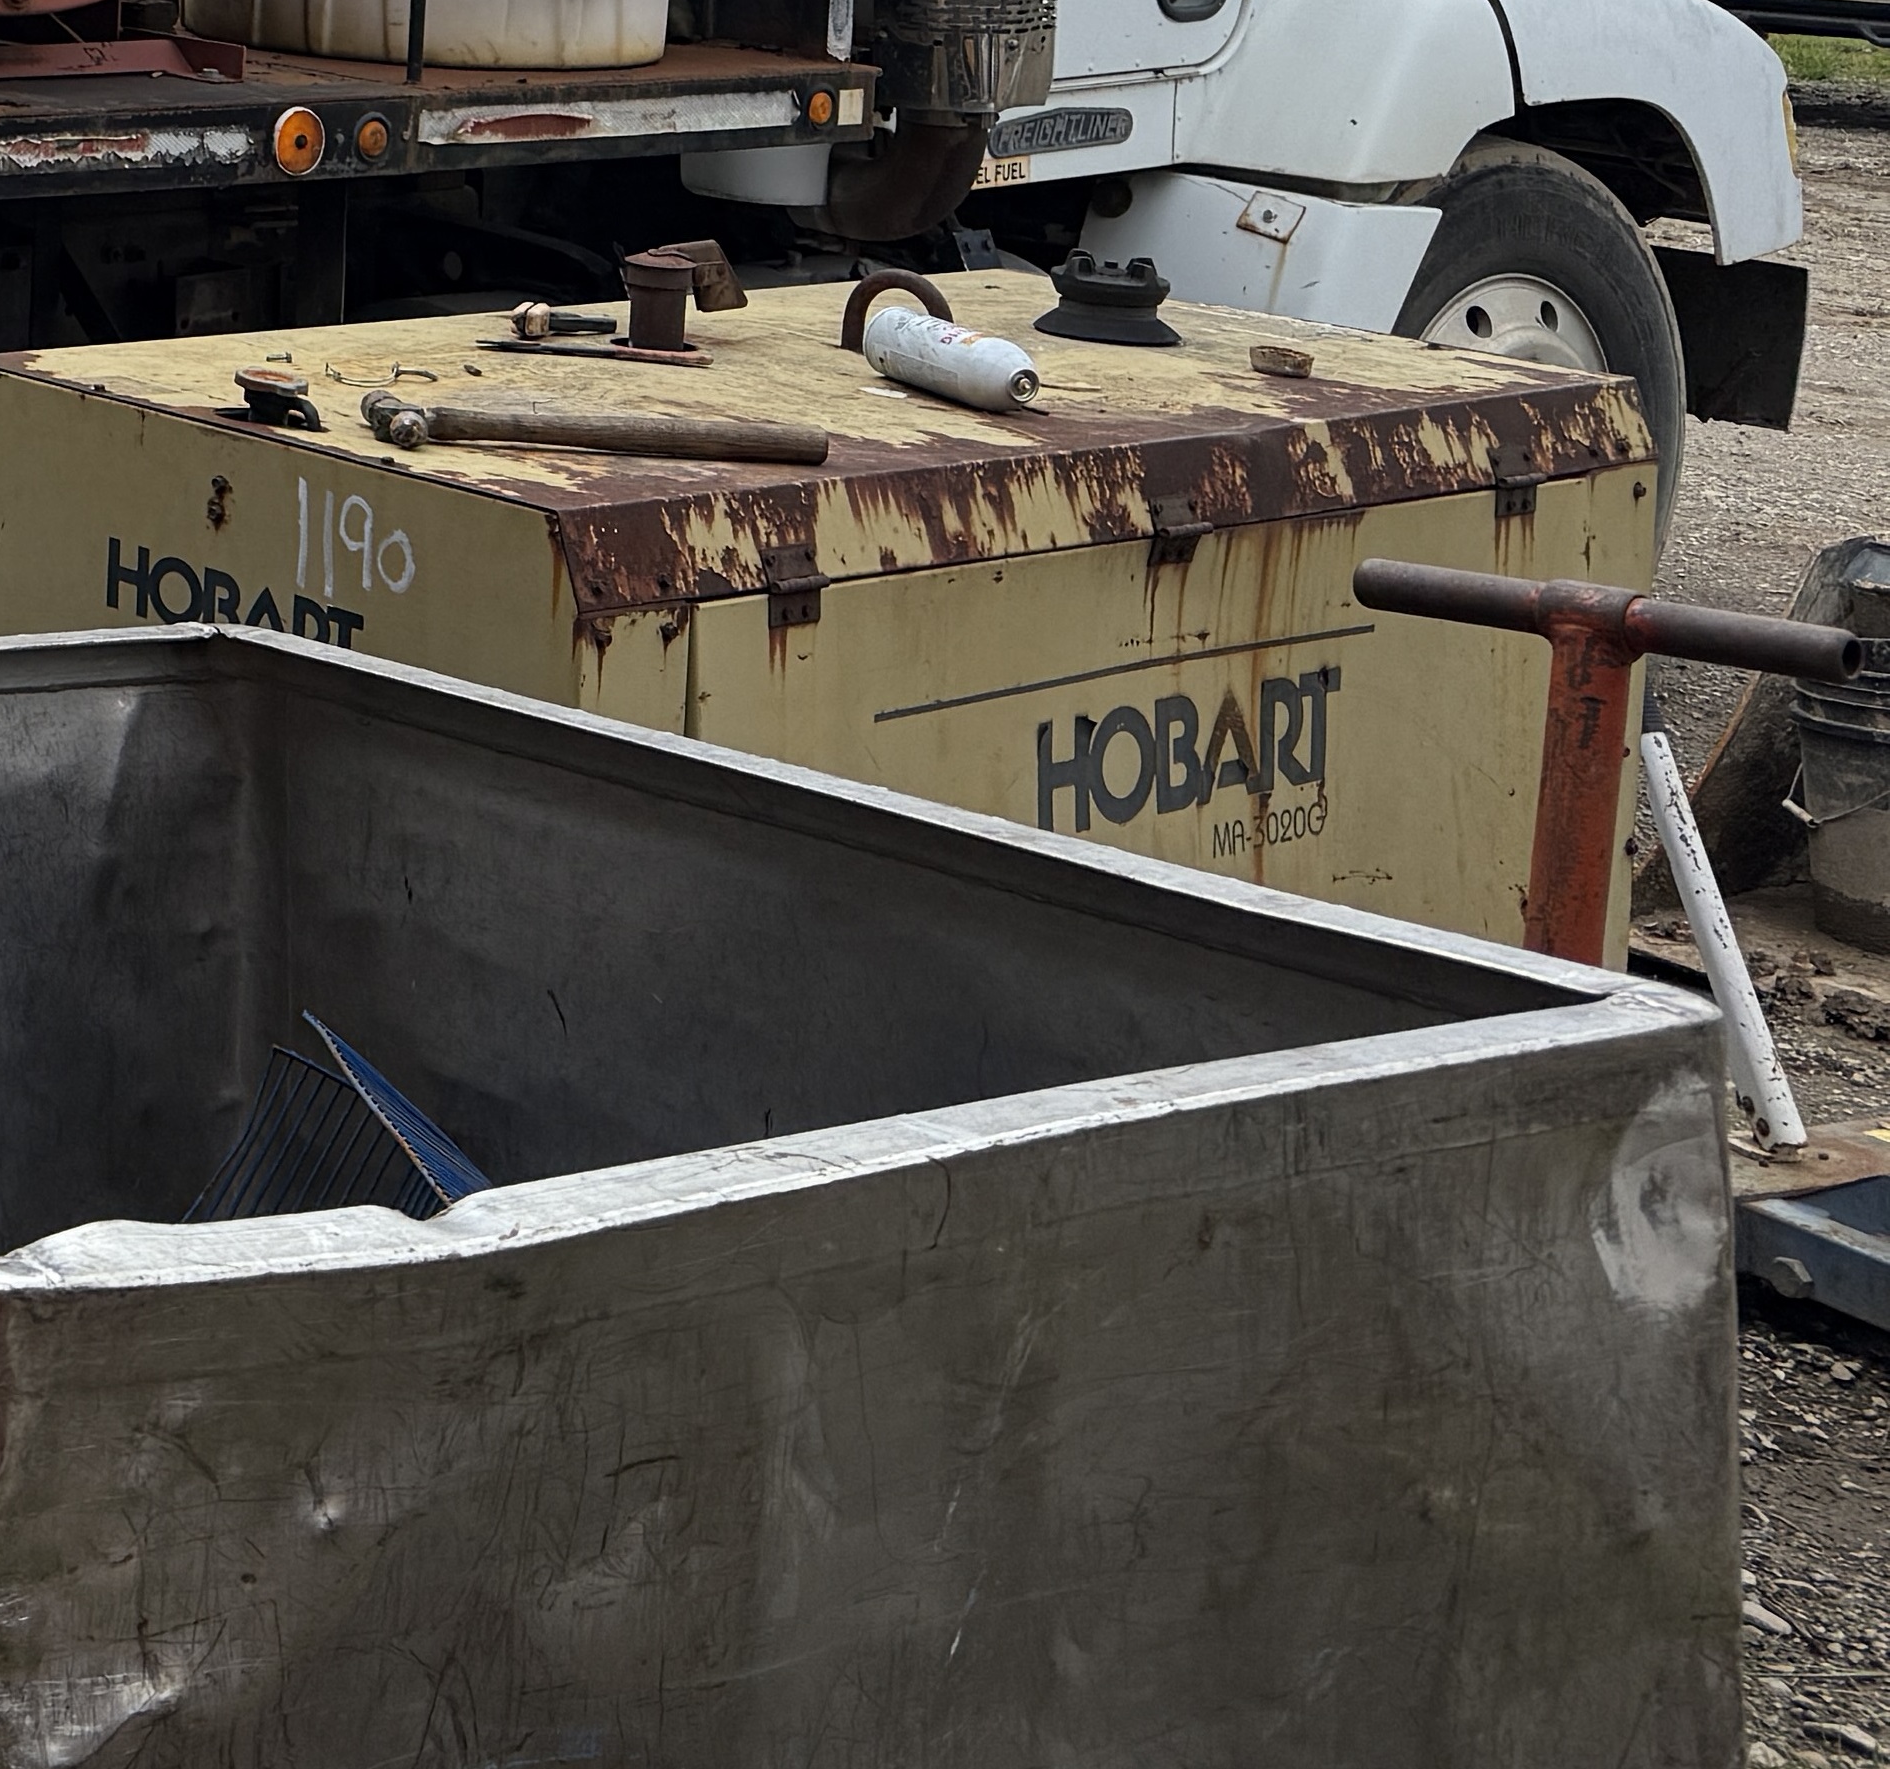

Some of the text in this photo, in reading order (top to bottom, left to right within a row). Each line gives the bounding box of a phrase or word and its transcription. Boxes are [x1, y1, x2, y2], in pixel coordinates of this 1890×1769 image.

[994, 162, 1026, 182] FUEL
[998, 113, 1127, 151] FREIGHTLINER
[296, 475, 416, 599] 1190
[1036, 665, 1341, 833] HOBART
